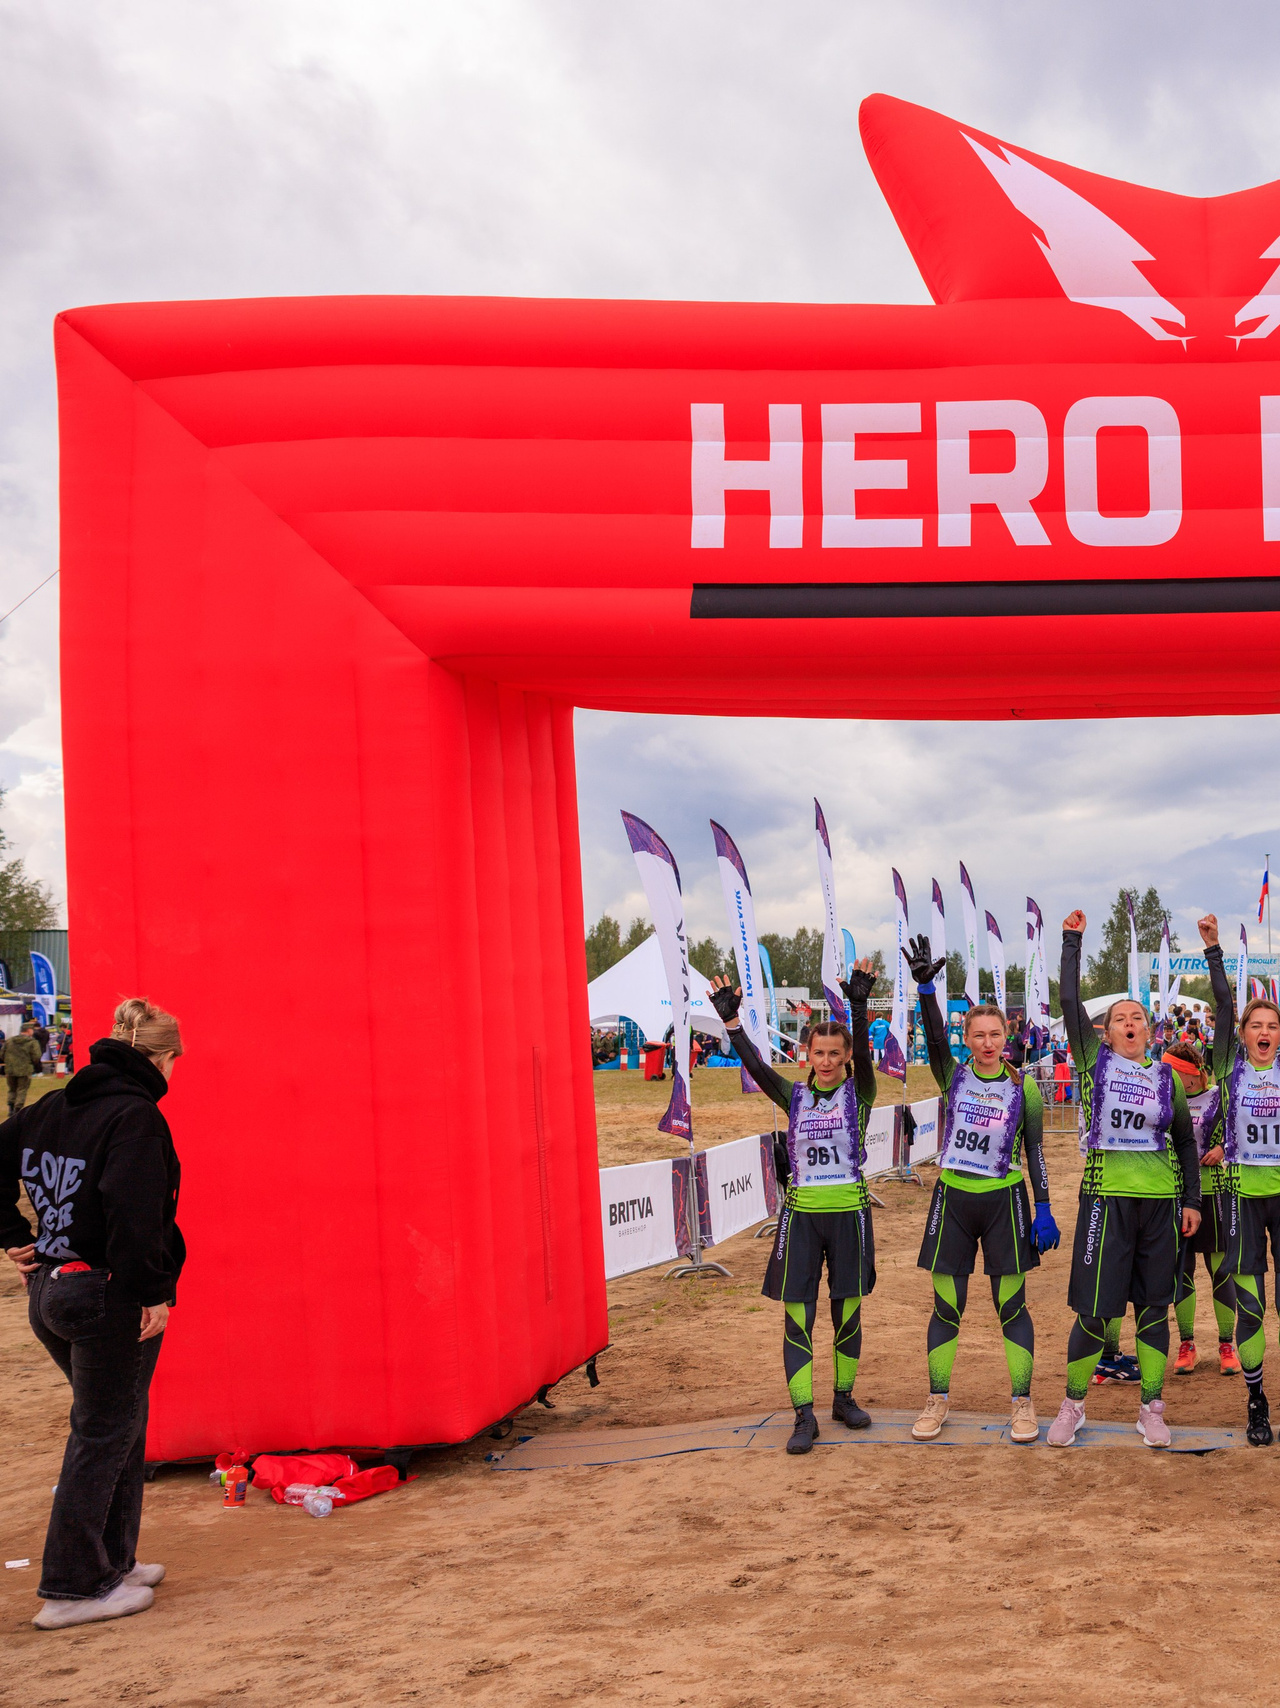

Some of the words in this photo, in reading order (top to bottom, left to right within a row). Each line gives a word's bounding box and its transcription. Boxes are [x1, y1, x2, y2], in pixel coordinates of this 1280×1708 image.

[690, 396, 1183, 549] HERO
[1111, 1082, 1154, 1098] МАССОВЫЙ
[1120, 1093, 1144, 1104] СТАРТ
[958, 1102, 1003, 1119] МАССОВЫЙ
[966, 1113, 990, 1126] СТАРТ
[1110, 1108, 1146, 1130] 970
[1252, 1107, 1276, 1117] СТАРТ
[800, 1119, 842, 1131] МАССОВЫЙ
[1246, 1123, 1280, 1145] 911
[808, 1130, 831, 1140] СТАРТ
[954, 1129, 991, 1155] 994
[806, 1145, 840, 1167] 961
[721, 1173, 753, 1201] TANK
[609, 1196, 654, 1227] BRITVA
[618, 1225, 647, 1238] BARBERSHOP
[1084, 1205, 1102, 1265] Greenway
